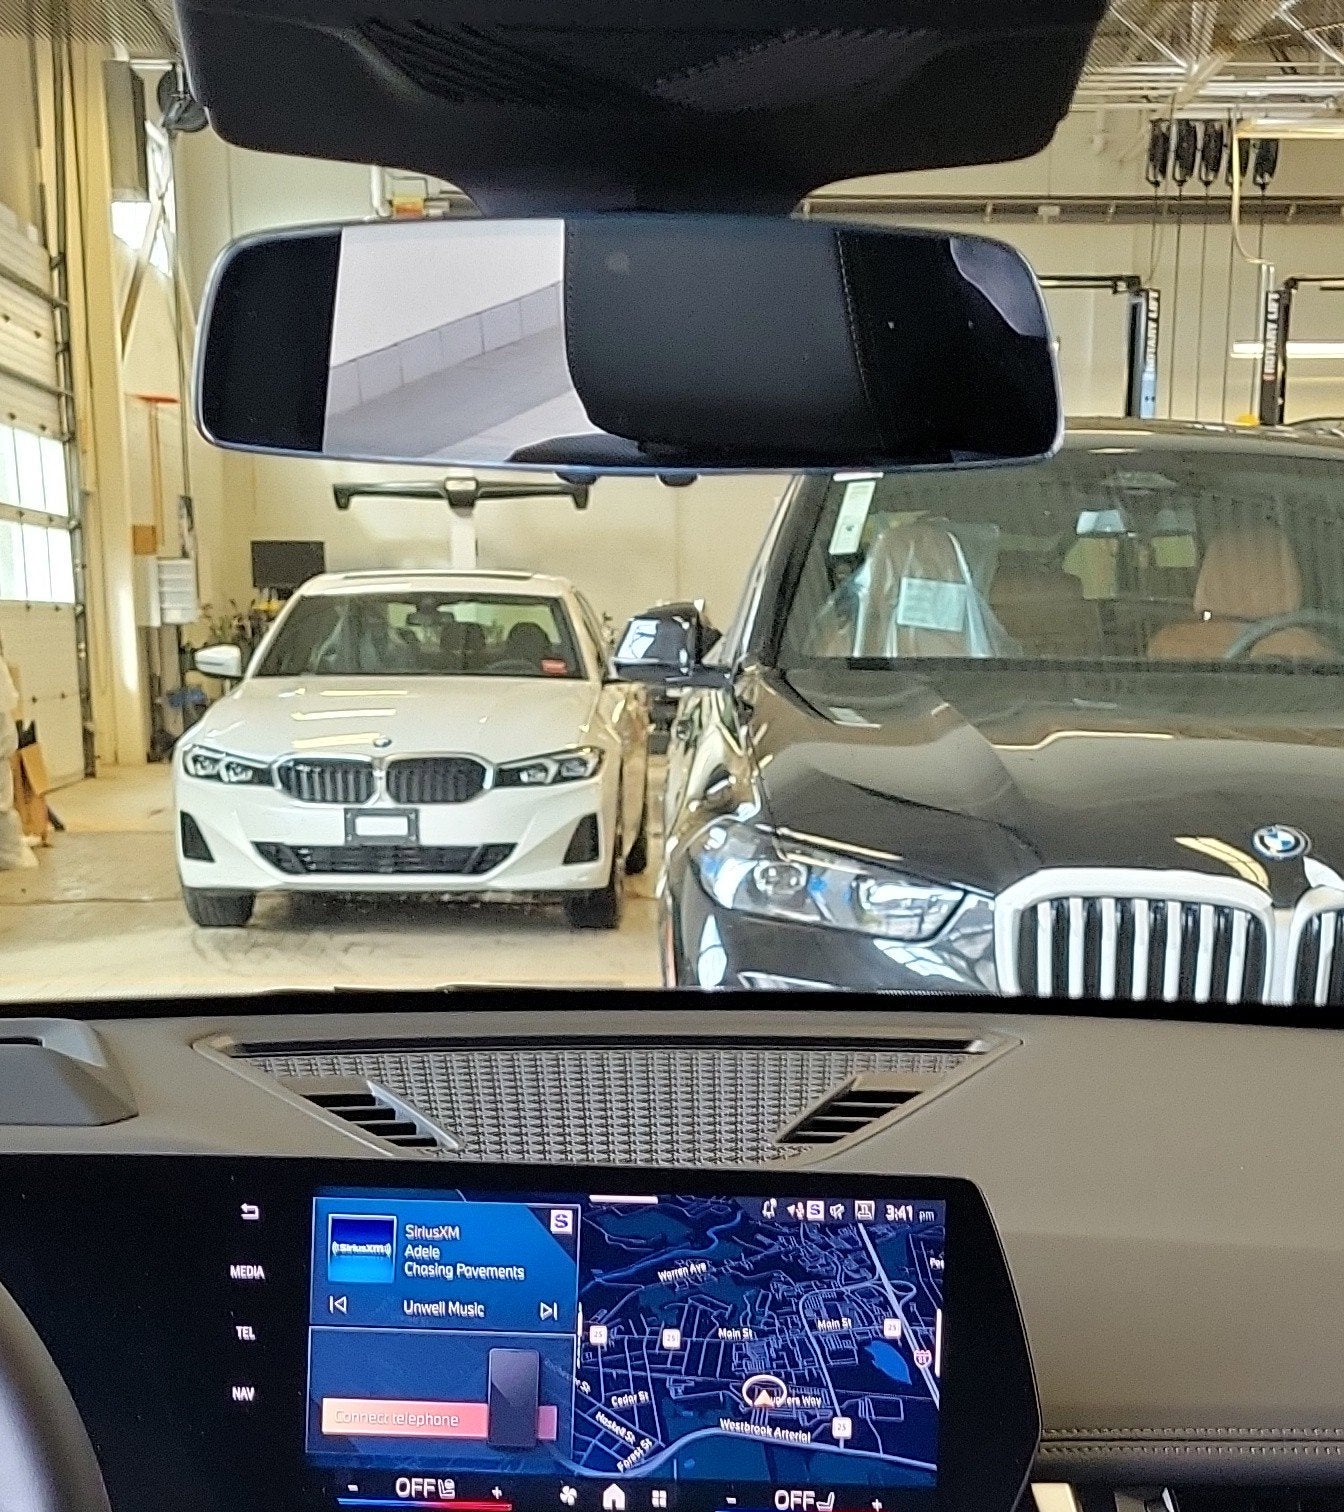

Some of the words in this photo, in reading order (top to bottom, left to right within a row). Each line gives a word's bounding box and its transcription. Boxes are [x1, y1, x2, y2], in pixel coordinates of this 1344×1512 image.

[1267, 292, 1280, 319] LIFT
[1263, 322, 1278, 373] ROTARY
[885, 1203, 914, 1222] 3:41
[919, 1210, 935, 1223] pm
[406, 1225, 460, 1241] SiriusXM
[404, 1244, 440, 1260] Adele
[230, 1265, 265, 1279] MEDIA
[404, 1262, 453, 1281] Chasing
[456, 1264, 525, 1281] Pavements
[657, 1267, 689, 1282] Warren
[690, 1262, 707, 1275] Ave
[403, 1299, 446, 1317] Unwell
[448, 1301, 485, 1318] Music
[236, 1326, 256, 1340] TEL
[817, 1319, 839, 1331] Main
[840, 1317, 853, 1329] St
[718, 1328, 741, 1341] Main
[742, 1328, 754, 1340] St
[232, 1386, 255, 1401] NAV
[611, 1394, 637, 1408] Cedar
[638, 1390, 650, 1405] St
[802, 1396, 821, 1408] Way
[335, 1410, 388, 1424] Connect
[392, 1413, 459, 1428] telephone
[720, 1418, 773, 1437] Westbrook
[773, 1427, 811, 1444] Arterial
[396, 1477, 436, 1499] OFF
[775, 1490, 815, 1511] OFF
